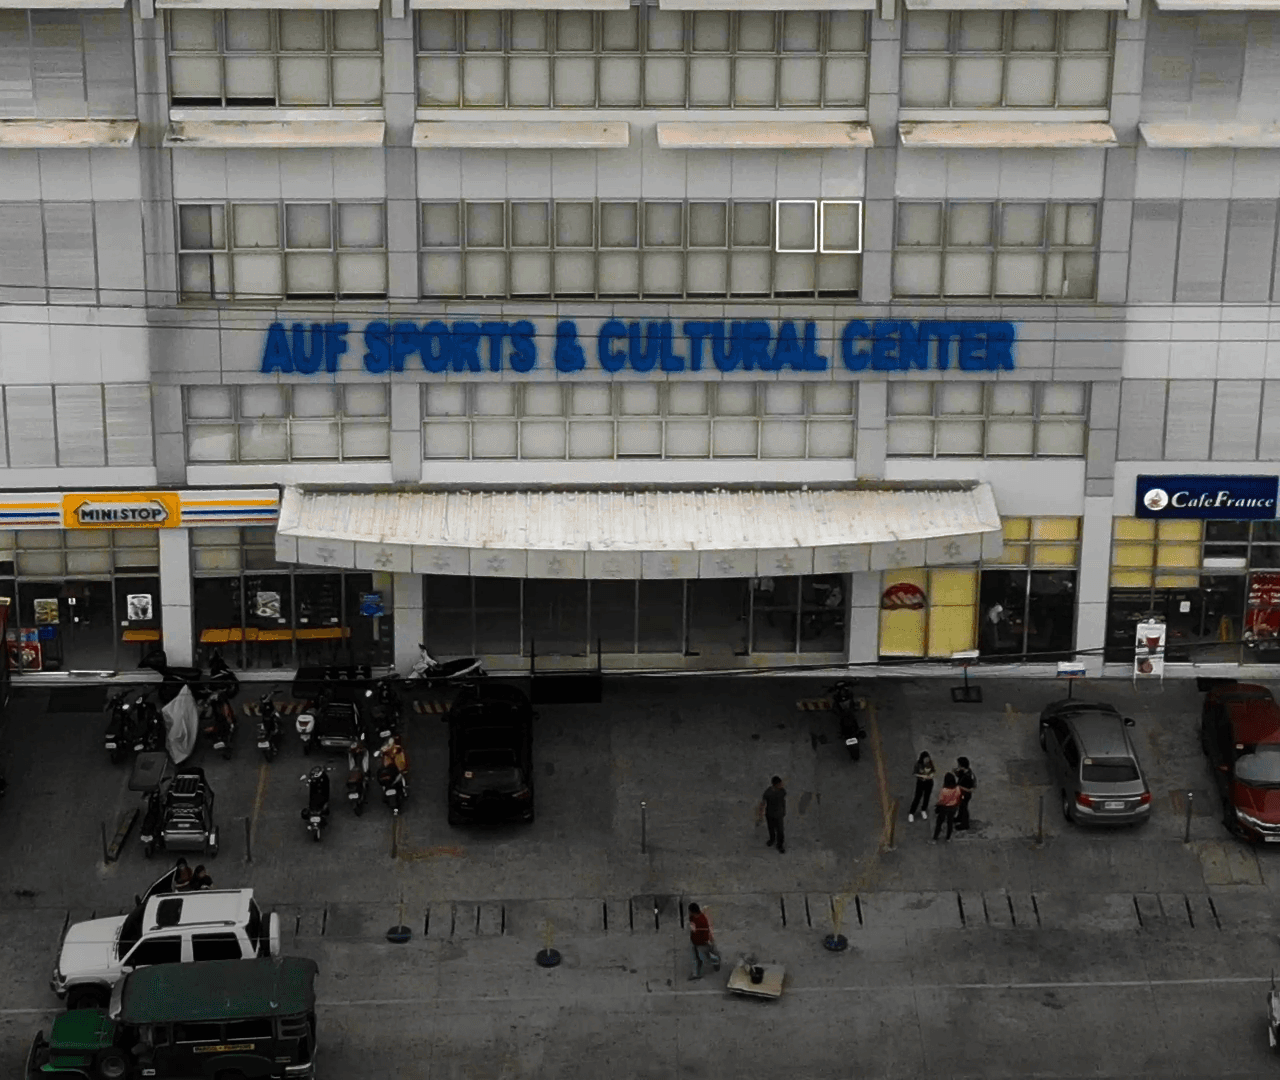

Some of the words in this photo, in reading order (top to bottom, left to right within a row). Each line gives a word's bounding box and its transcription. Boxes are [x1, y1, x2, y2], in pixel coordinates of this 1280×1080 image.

[260, 321, 350, 374] AUF
[364, 320, 537, 374] SPORTS
[554, 320, 587, 373] &
[598, 320, 828, 373] CULTURAL
[841, 320, 1018, 373] CENTER
